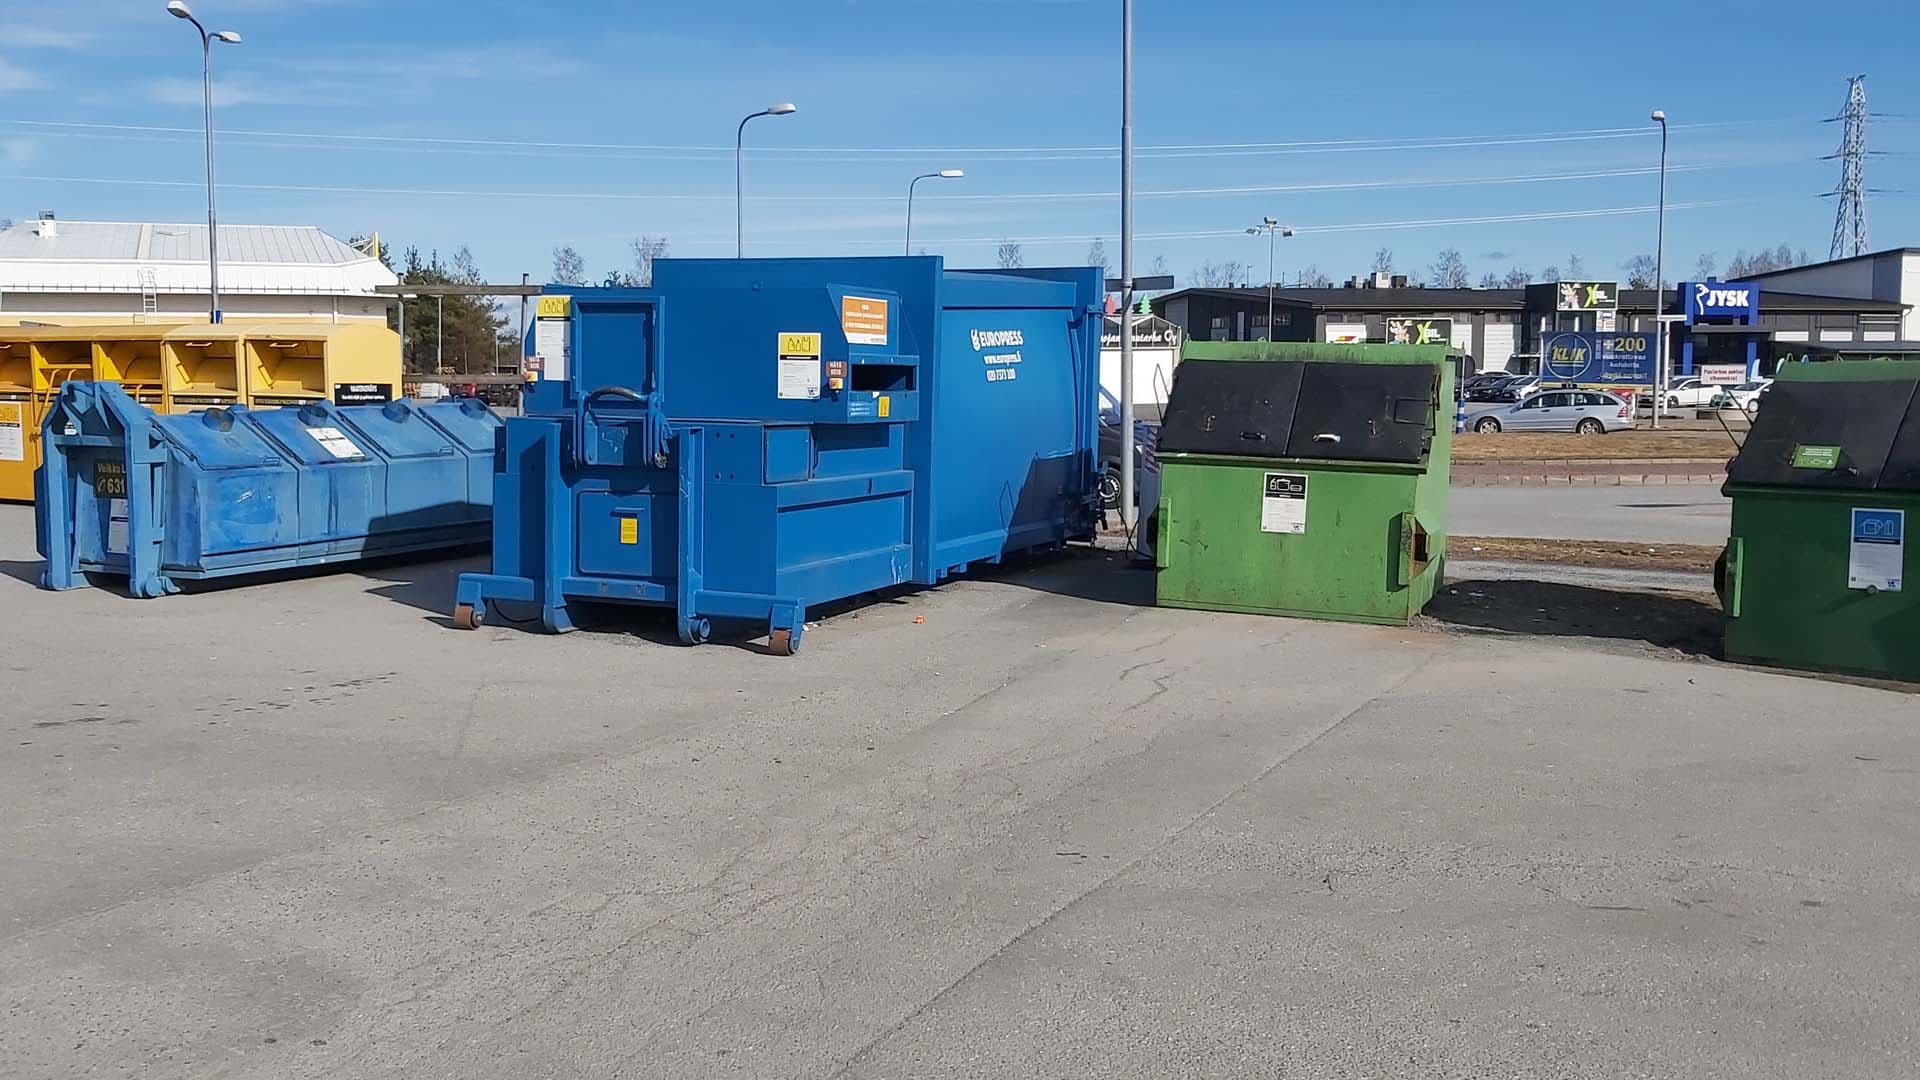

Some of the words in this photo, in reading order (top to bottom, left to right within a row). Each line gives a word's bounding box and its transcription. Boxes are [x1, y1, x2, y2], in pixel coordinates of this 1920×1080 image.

[1706, 290, 1750, 307] JYSK
[979, 330, 1024, 347] EUROPRESS
[1164, 330, 1177, 346] Oy
[1552, 346, 1587, 361] KLIK
